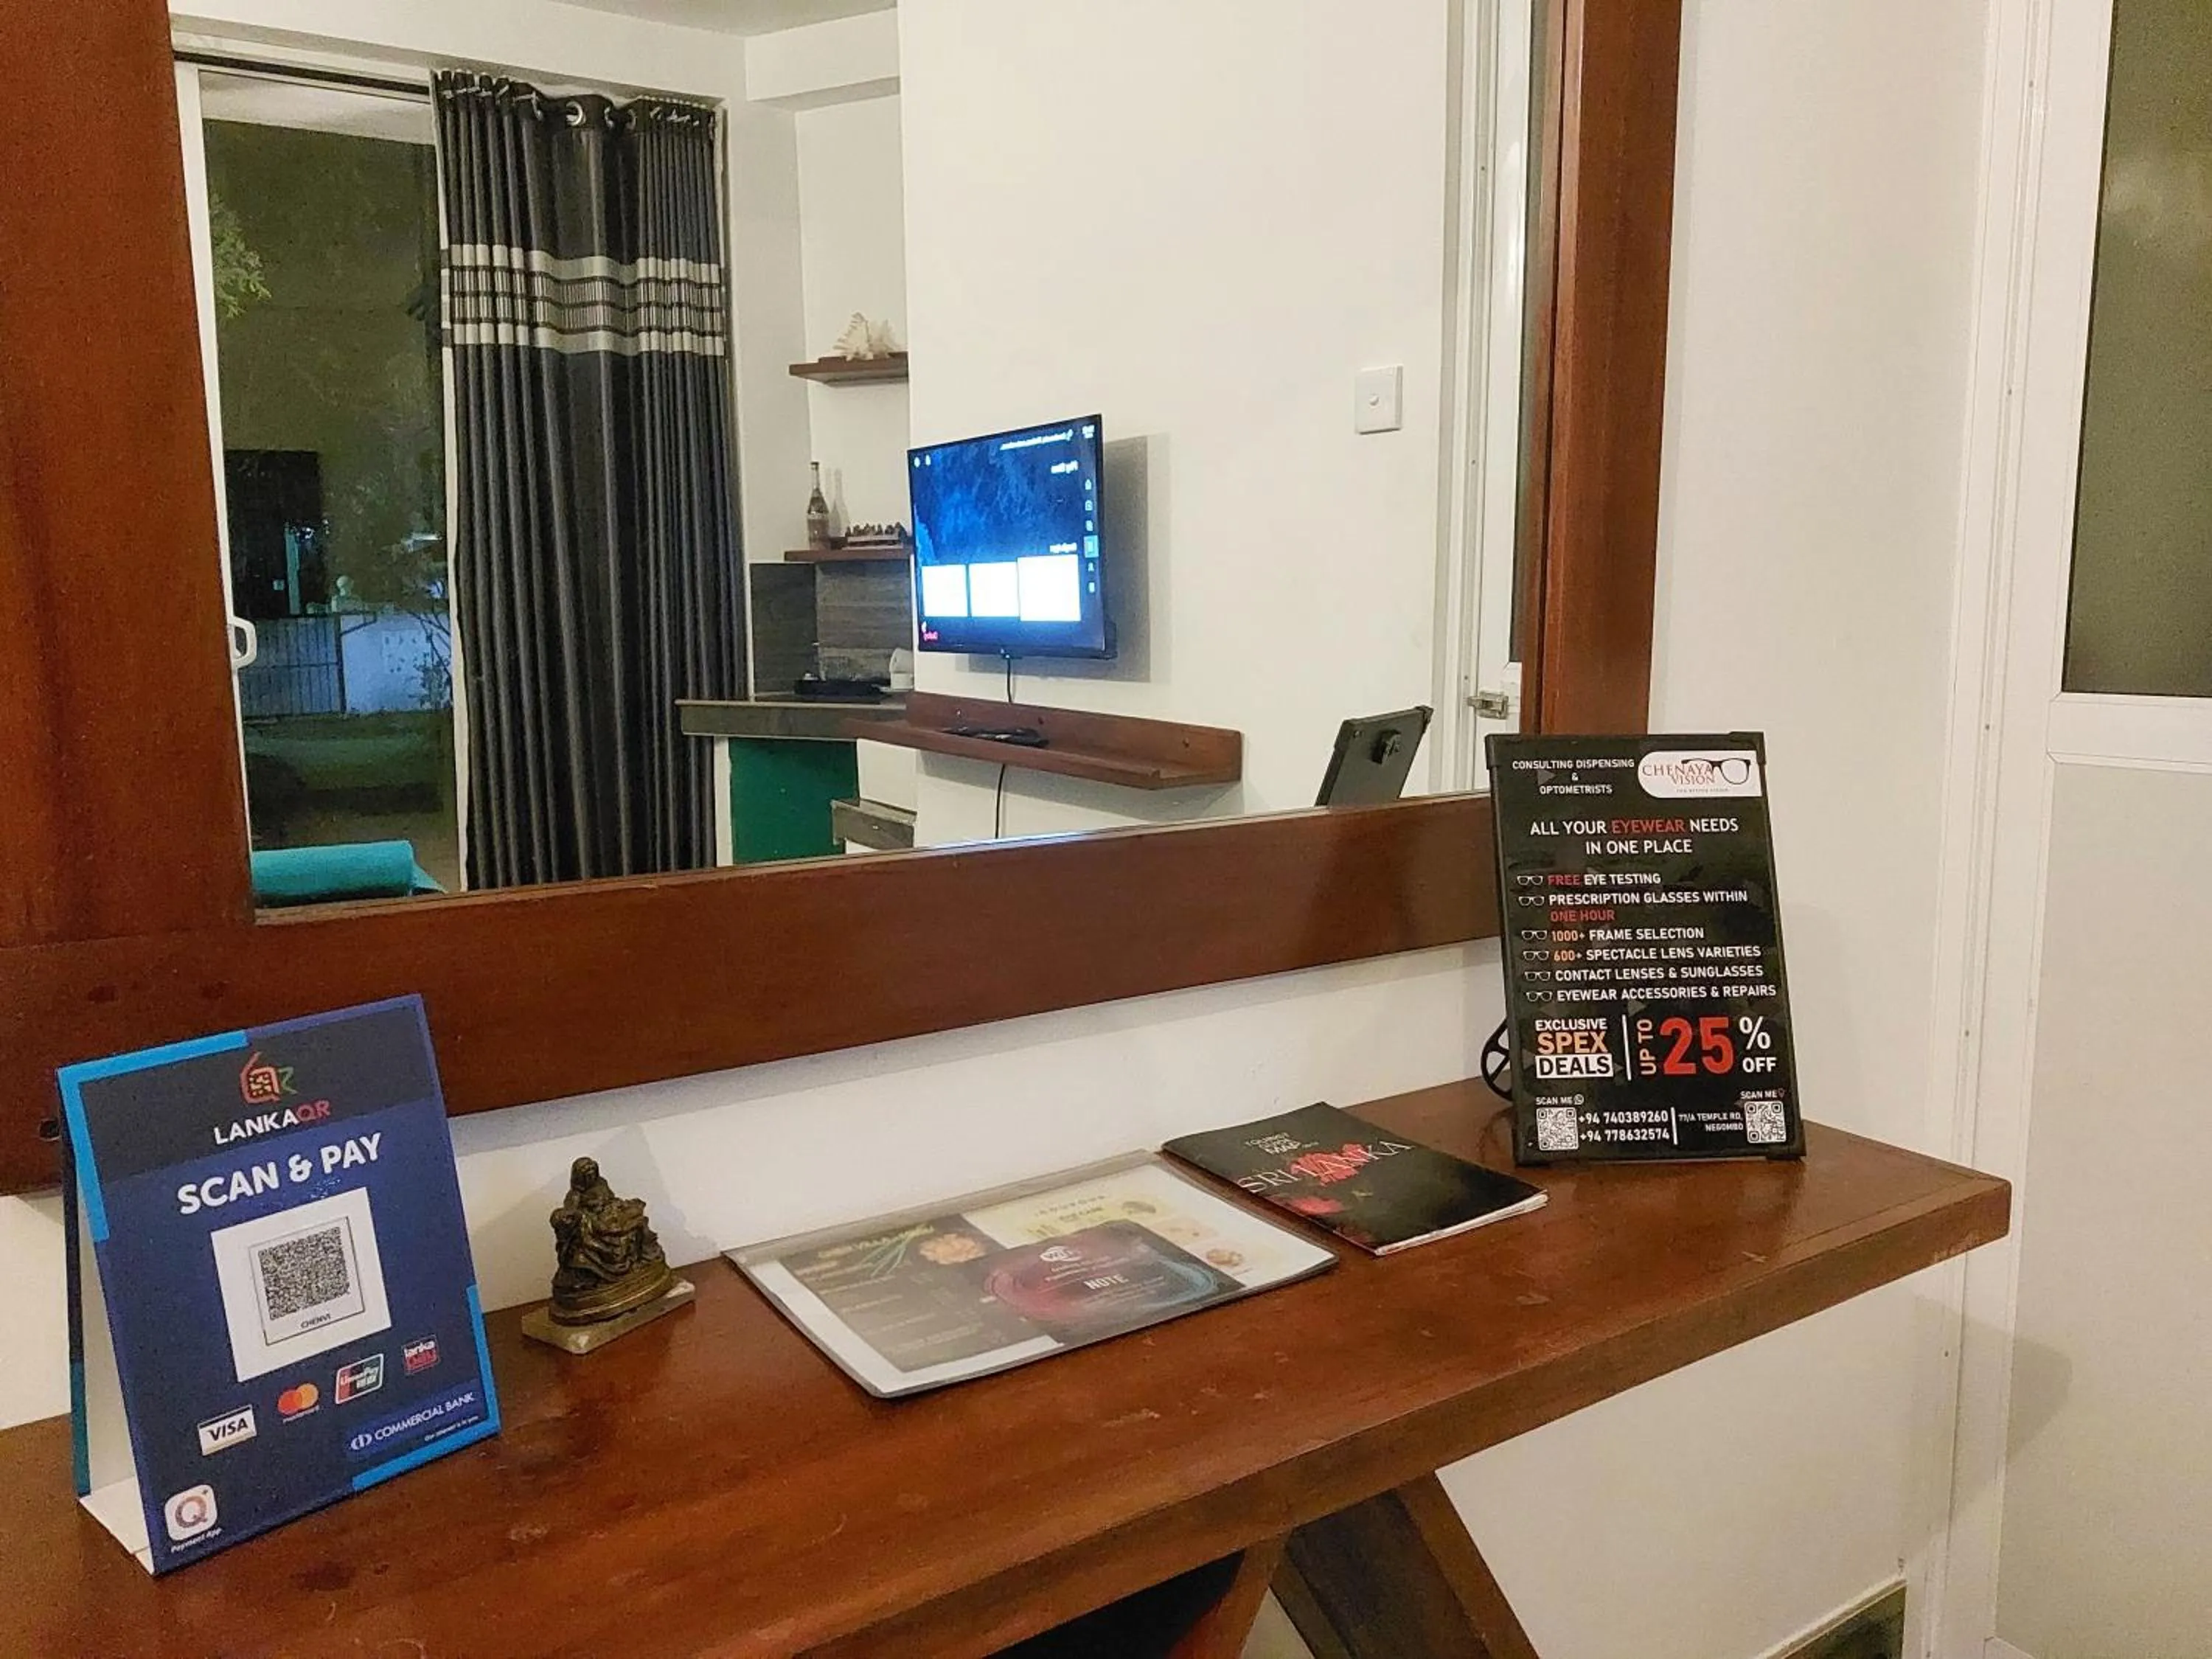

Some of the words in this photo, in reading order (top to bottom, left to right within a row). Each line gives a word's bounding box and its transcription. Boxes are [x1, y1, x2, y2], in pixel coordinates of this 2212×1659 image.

[1512, 759, 1573, 771] CONSULTING
[1576, 758, 1635, 769] DISPENSING
[1642, 764, 1714, 776] CHENAYA
[1571, 772, 1579, 782] &
[1671, 775, 1716, 785] VISION
[1540, 784, 1613, 795] OPTOMETRISTS
[1530, 821, 1559, 835] ALL
[1562, 820, 1607, 835] YOUR
[1611, 818, 1686, 834] EYEWEAR
[1689, 818, 1739, 832] NEEDS
[1585, 841, 1601, 855] IN
[1606, 840, 1639, 855] ONE
[1644, 838, 1693, 854] PLACE
[1548, 874, 1581, 886] FREE
[1584, 874, 1607, 885] EYE
[1610, 873, 1661, 885] TESTING
[1549, 892, 1640, 905] PRESCRIPTION
[1644, 891, 1700, 904] GLASSES
[1703, 890, 1748, 902] WITHIN
[1551, 910, 1577, 922] ONE
[1580, 909, 1615, 922] HOUR
[1551, 929, 1585, 942] 1000+
[1589, 929, 1632, 942] FRAME
[1636, 927, 1704, 940] SELECTION
[1553, 950, 1583, 961] 600+
[1586, 948, 1658, 961] SPECTACLE
[1660, 947, 1694, 959] LENS
[1697, 945, 1761, 958] VARIETIES
[1555, 969, 1613, 982] CONTACT
[1615, 968, 1665, 981] LENSES
[1668, 967, 1678, 979] &
[1680, 965, 1764, 978] SUNGLASSES
[1557, 988, 1617, 1002] EYEWEAR
[1621, 986, 1708, 1001] ACCESSORIES
[1711, 986, 1720, 998] &
[1722, 984, 1777, 998] REPAIRS
[1535, 1018, 1608, 1032] EXCLUSIVE
[1637, 1019, 1654, 1044] TO
[1537, 1032, 1609, 1055] SPEX
[1659, 1015, 1735, 1075] 25
[1539, 1056, 1611, 1076] DEALS
[1639, 1047, 1658, 1076] UP
[1742, 1057, 1777, 1074] OFF
[1536, 1096, 1559, 1105] SCAN
[1560, 1096, 1573, 1105] ME
[1740, 1090, 1763, 1099] SCAN
[1764, 1090, 1778, 1099] ME
[1579, 1112, 1601, 1125] +94
[1603, 1110, 1669, 1124] 740389260
[1697, 1112, 1728, 1121] TEMPLE
[1580, 1130, 1601, 1143] +94
[1604, 1128, 1670, 1142] 778632574
[177, 1161, 279, 1215] SCAN
[288, 1153, 313, 1182] &
[319, 1133, 383, 1174] PAY
[1239, 1167, 1301, 1194] SRI
[1296, 1139, 1416, 1184] LANKA
[1084, 1273, 1130, 1290] NOTE
[375, 1405, 444, 1440] COMMERCIAL
[445, 1392, 475, 1412] BANK
[206, 1416, 249, 1442] VISA
